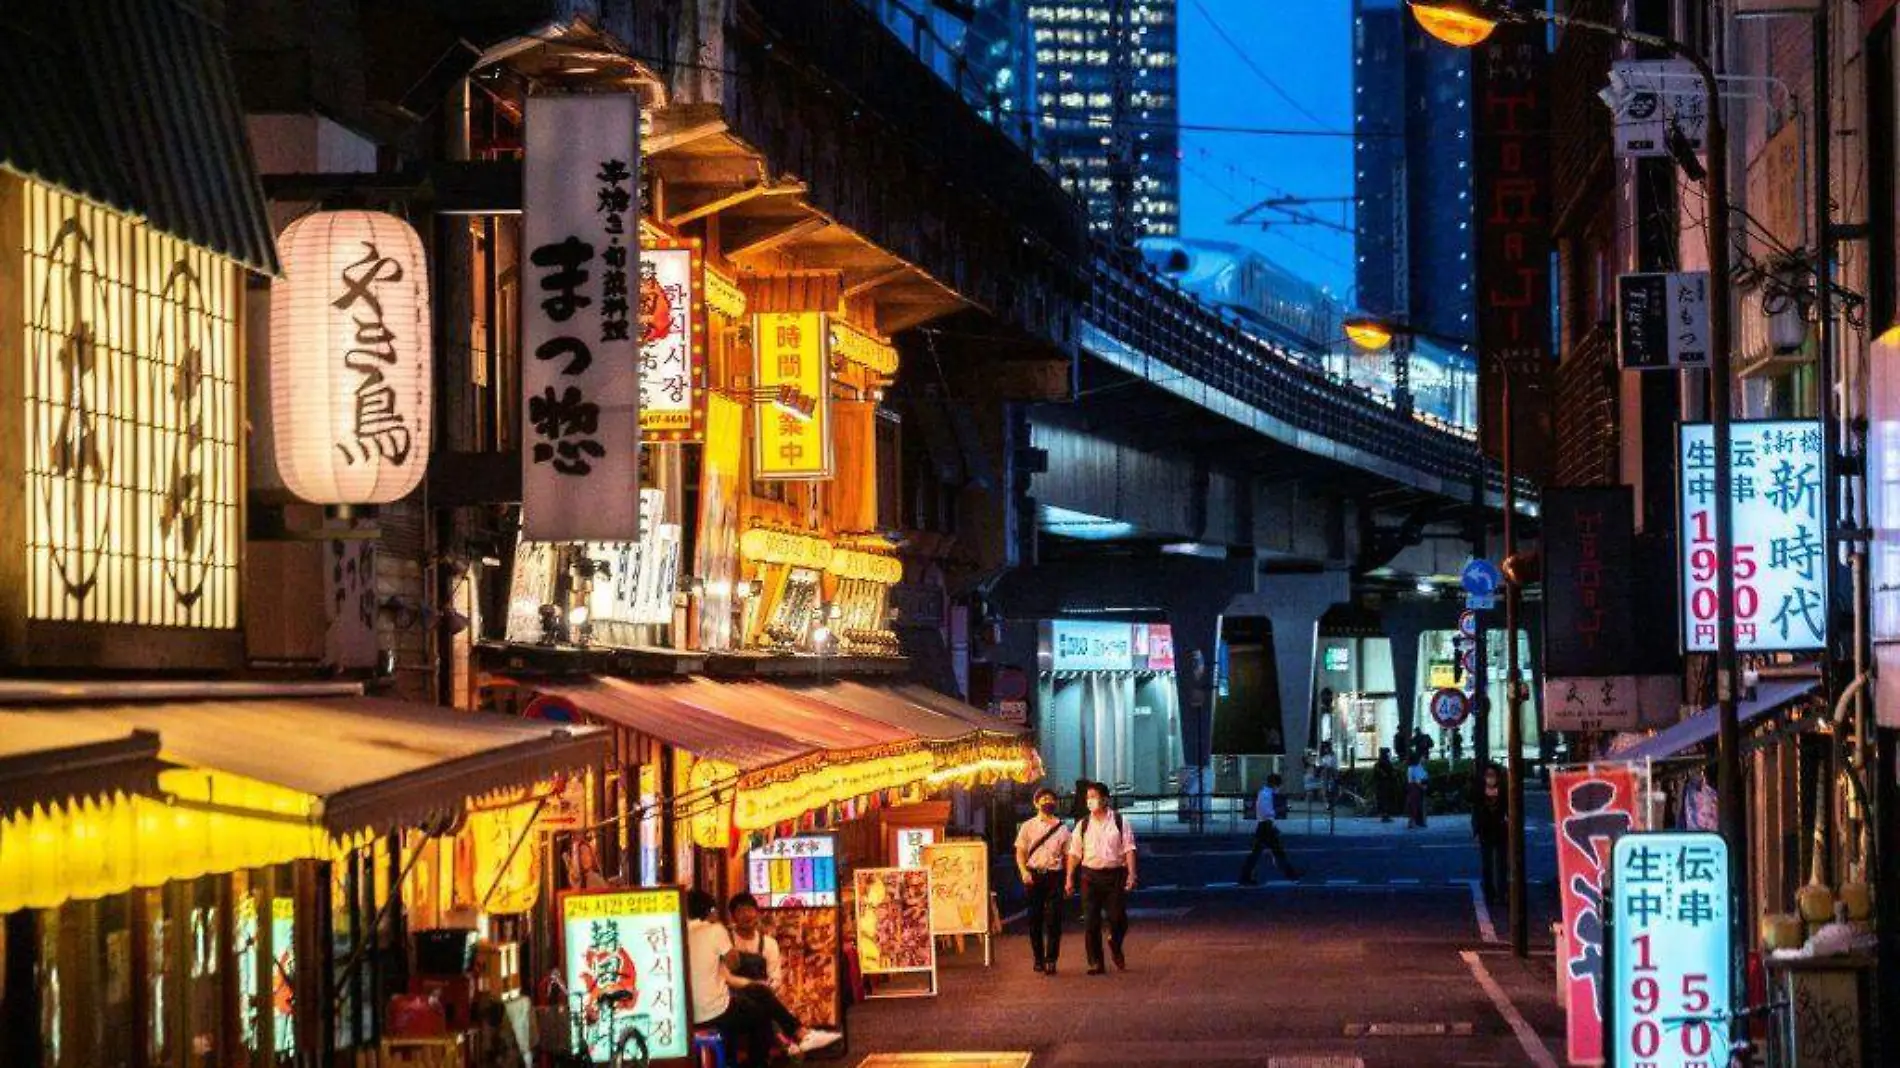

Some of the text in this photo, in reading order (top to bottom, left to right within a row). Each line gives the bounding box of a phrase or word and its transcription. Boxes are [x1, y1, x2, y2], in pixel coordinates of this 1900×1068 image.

[530, 236, 605, 476] まつ惣
[1765, 459, 1824, 642] 新時代
[1626, 845, 1663, 927] 生中
[1676, 845, 1715, 928] 伝串
[645, 925, 676, 1047] 한식시장
